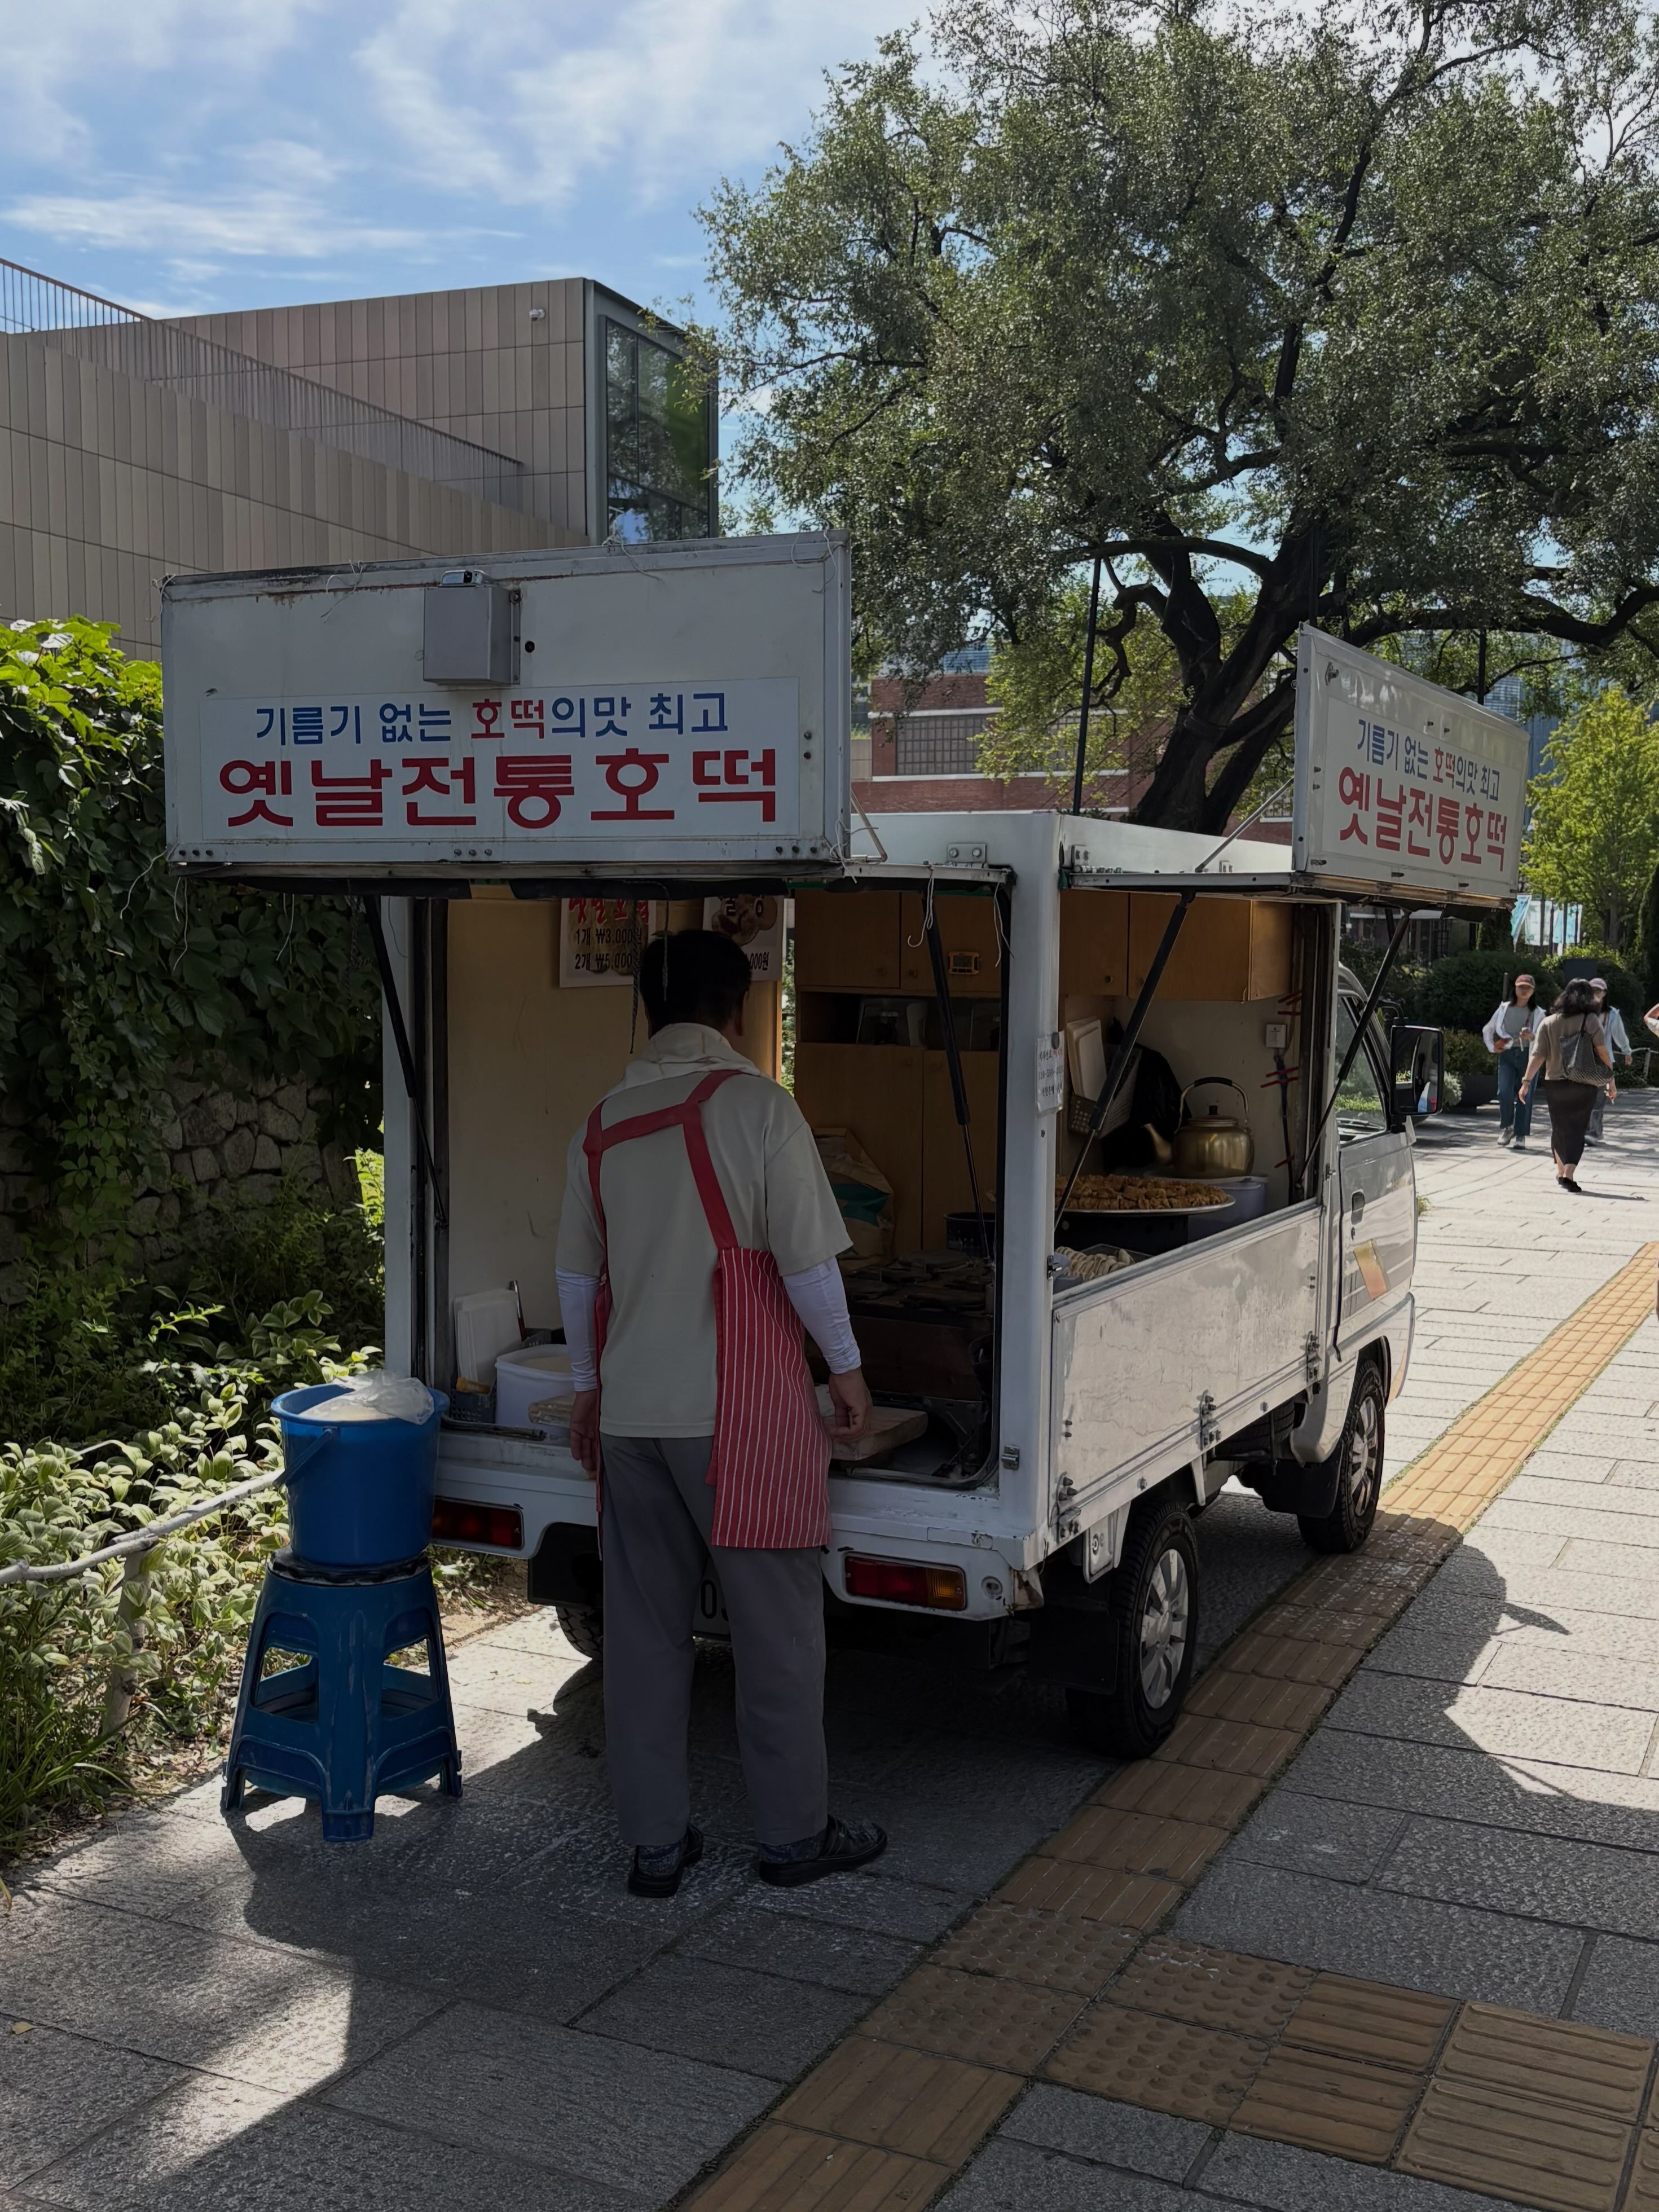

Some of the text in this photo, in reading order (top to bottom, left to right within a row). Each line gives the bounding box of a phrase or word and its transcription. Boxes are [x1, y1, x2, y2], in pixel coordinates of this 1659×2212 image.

[255, 692, 729, 746] 기름기 없는 호떡의맛 최고
[219, 747, 776, 829] 옛날전통호떡
[1357, 719, 1500, 802] 기름기 없는 호떡의맛 최고
[1338, 766, 1508, 872] 옛날전통호떡
[575, 952, 591, 970] 2개
[576, 927, 591, 947] 1개
